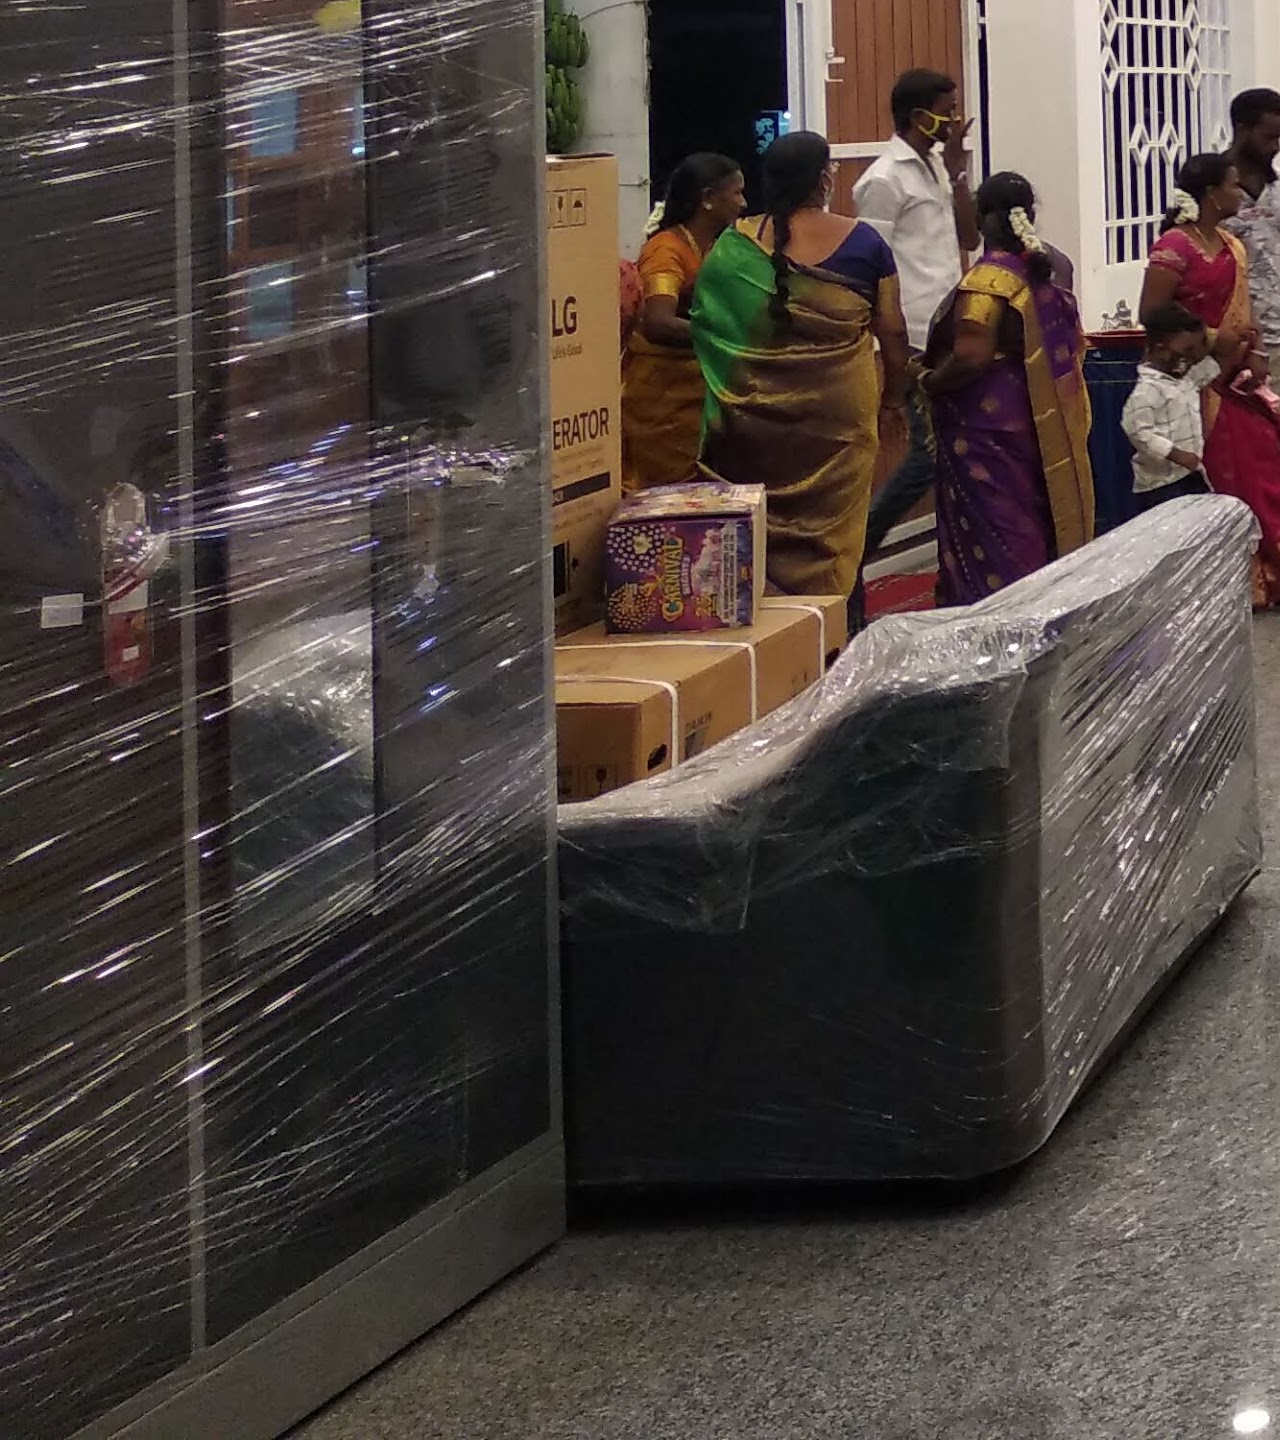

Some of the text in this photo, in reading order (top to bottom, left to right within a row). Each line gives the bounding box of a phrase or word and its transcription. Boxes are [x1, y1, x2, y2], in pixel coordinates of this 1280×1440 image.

[552, 296, 577, 337] LG
[553, 407, 609, 451] ERATOR
[662, 537, 684, 620] CARNIVAL
